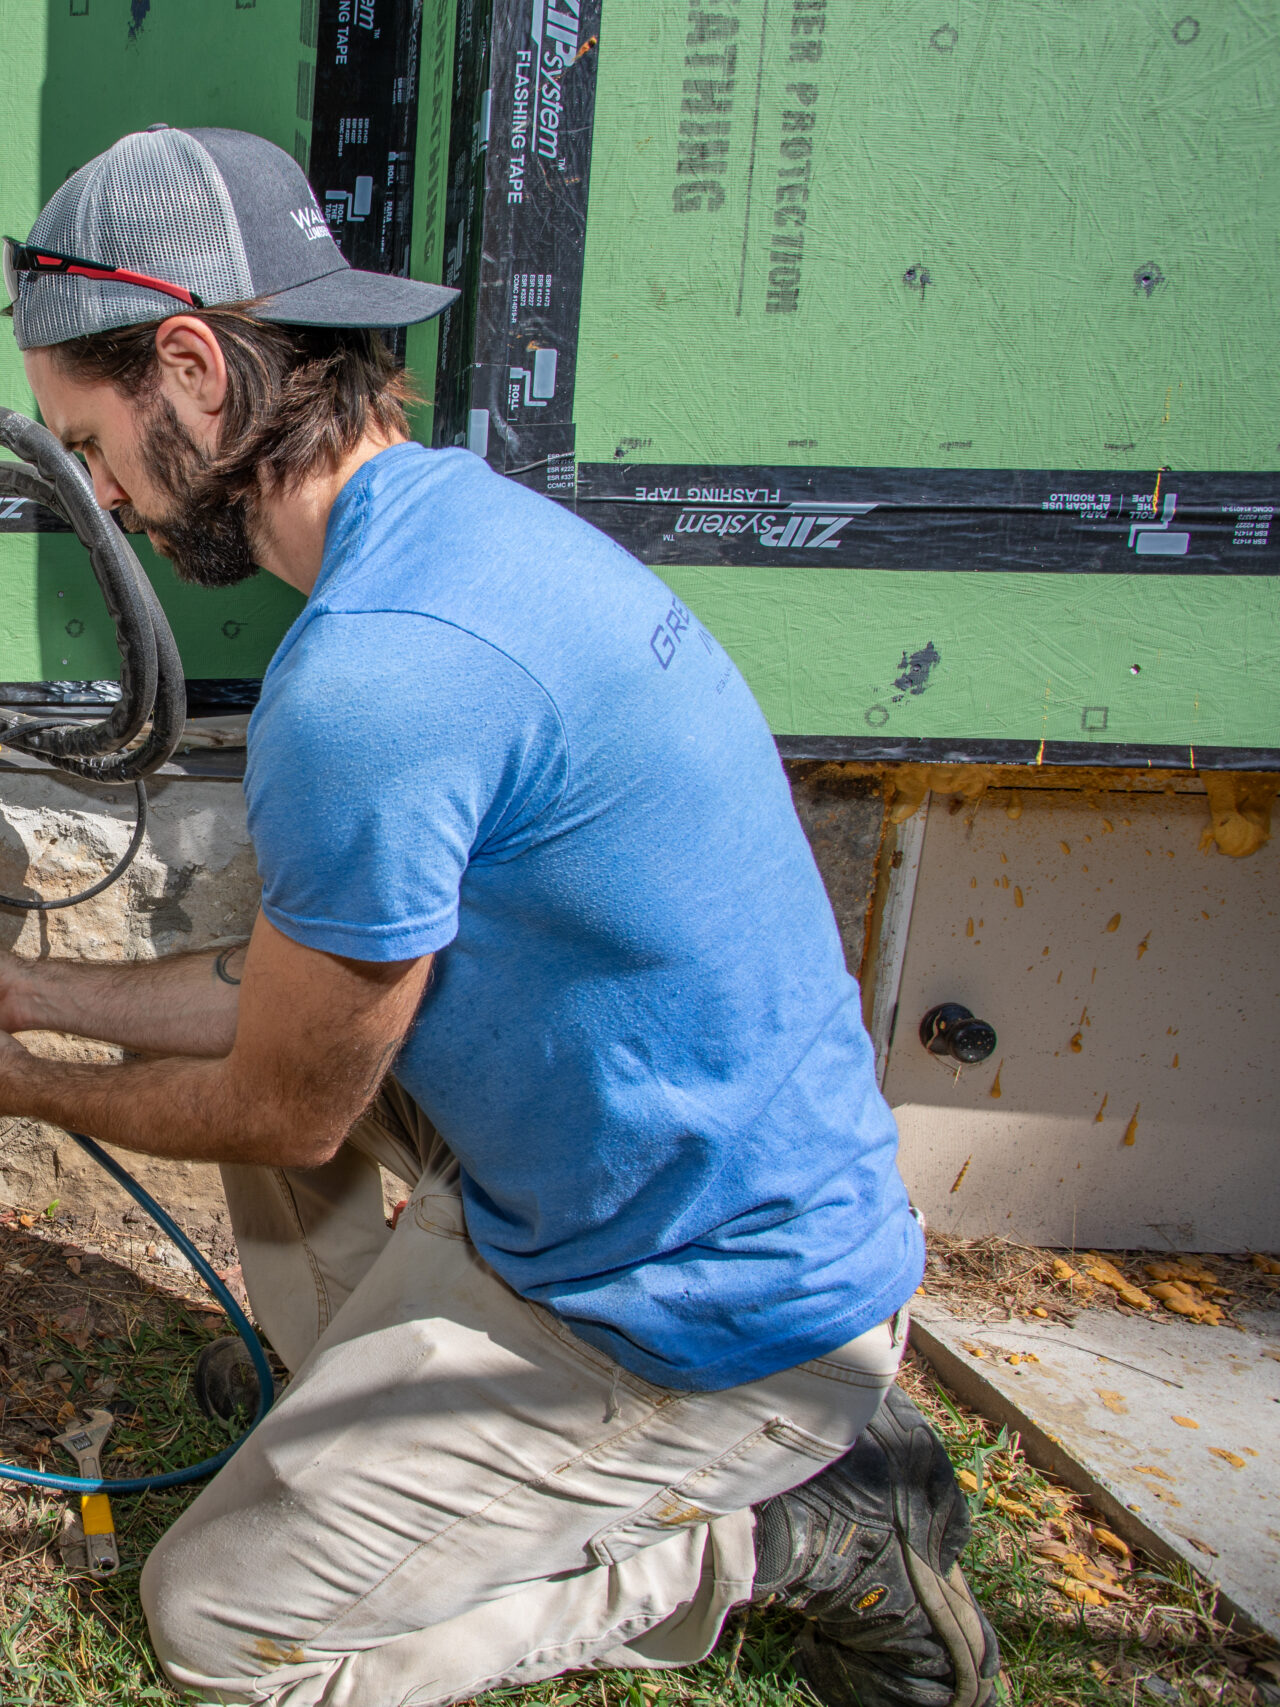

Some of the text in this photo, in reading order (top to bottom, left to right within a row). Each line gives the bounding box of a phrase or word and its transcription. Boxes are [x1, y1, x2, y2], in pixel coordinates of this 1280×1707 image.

[336, 29, 347, 65] TAPE
[672, 8, 739, 213] ATHING
[506, 50, 532, 205] FLASHING TAPE
[765, 82, 819, 314] PROTECTOR
[336, 204, 345, 224] ROLL
[511, 295, 519, 323] #14019-R
[511, 384, 521, 411] ROLL
[635, 487, 780, 503] FLASHING TAPE
[1042, 502, 1111, 510] APLICAR USE
[1049, 493, 1096, 502] RODILLO
[1080, 511, 1109, 519] PARA
